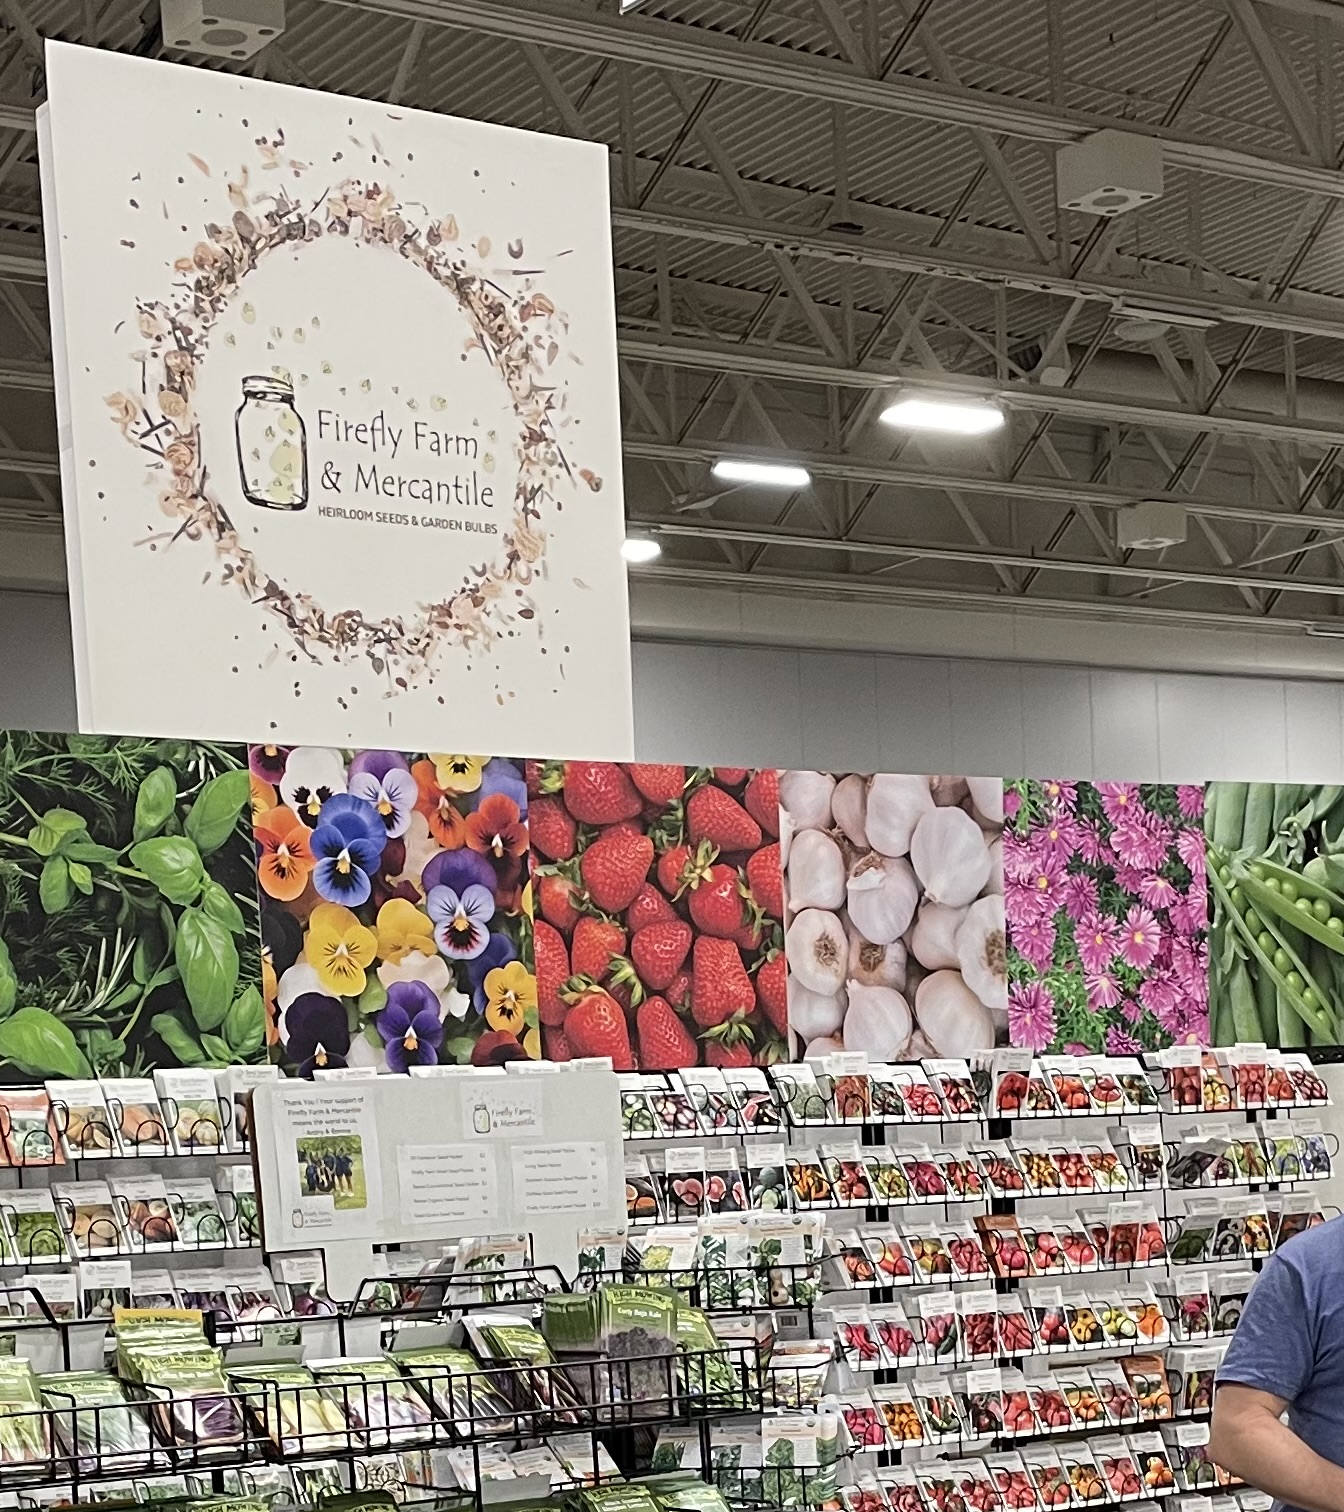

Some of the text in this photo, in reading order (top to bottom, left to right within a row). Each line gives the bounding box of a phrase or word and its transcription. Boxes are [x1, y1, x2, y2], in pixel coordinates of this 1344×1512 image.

[318, 409, 478, 458] Firefly Farm
[321, 461, 494, 507] & Mercantile
[318, 506, 498, 534] HEIRLOOM SEEDS & GARDEN BULBS
